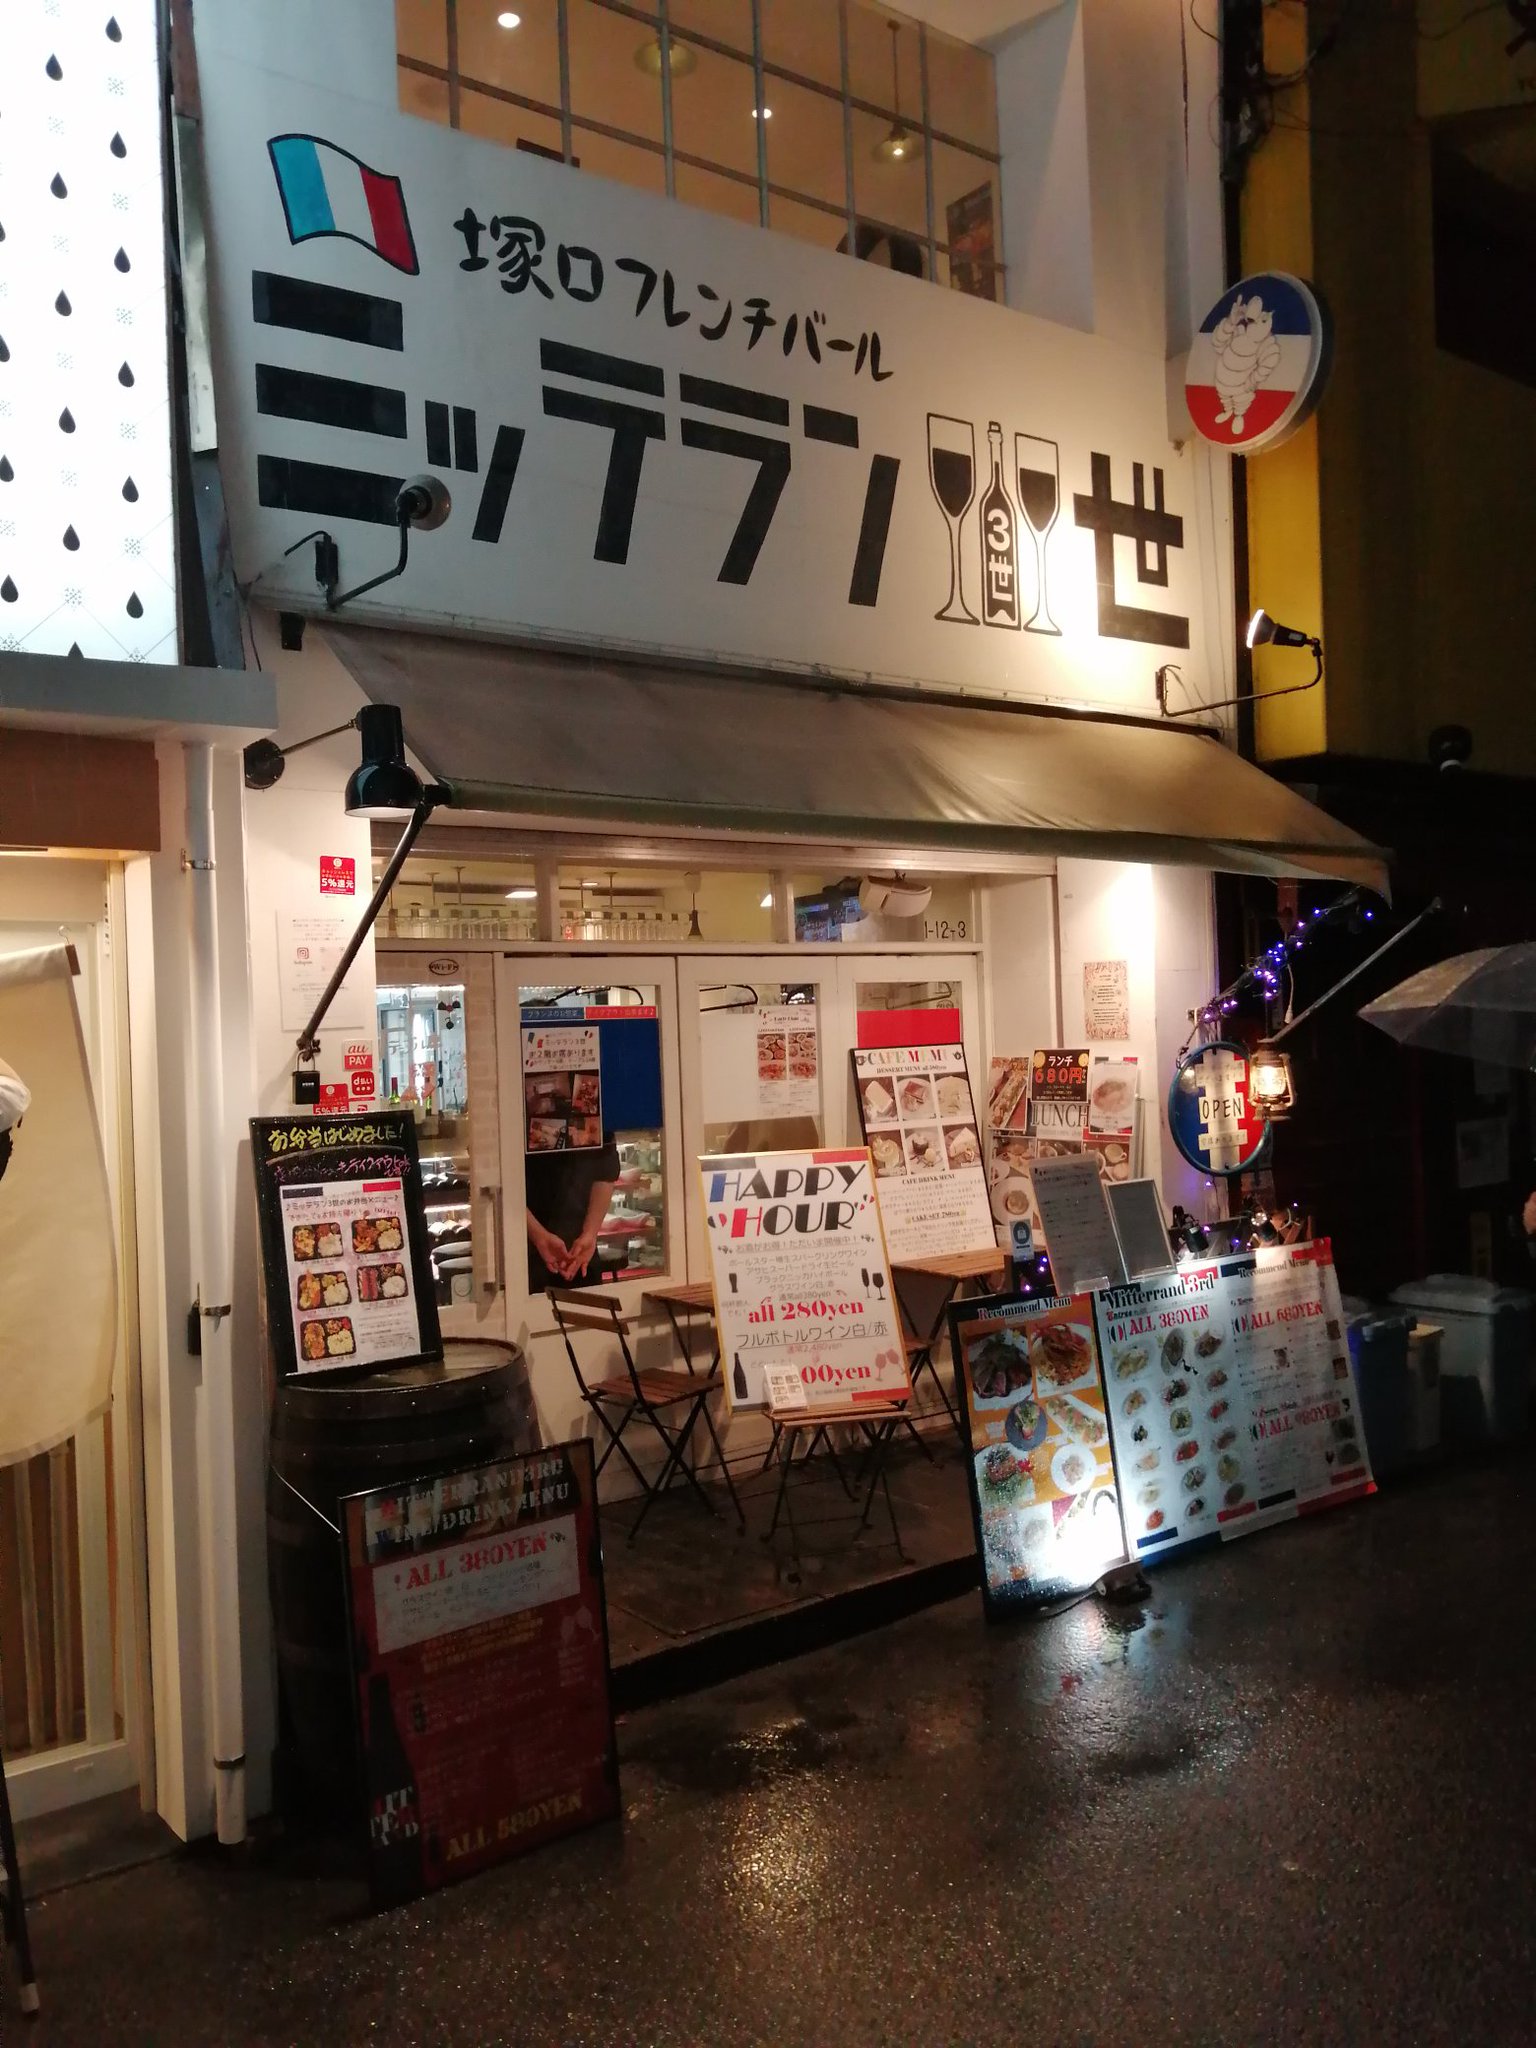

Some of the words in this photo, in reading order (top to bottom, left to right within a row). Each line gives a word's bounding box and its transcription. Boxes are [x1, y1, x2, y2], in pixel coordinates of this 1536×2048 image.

[453, 207, 893, 382] 塚口フレンチバール
[252, 270, 902, 607] ミッテラン
[924, 920, 967, 939] 1-12-3
[347, 1044, 369, 1054] au
[348, 1056, 368, 1066] PAY
[1048, 1055, 1073, 1067] ランチ
[1035, 1067, 1083, 1085] 680円
[1201, 1097, 1243, 1120] OPEN
[709, 1164, 866, 1203] HAPPY
[730, 1201, 856, 1238] HOUR
[1103, 1279, 1186, 1310] Mitterrand
[1188, 1272, 1215, 1293] 3rd
[748, 1303, 775, 1324] all
[780, 1299, 865, 1321] 280yen
[978, 1299, 1041, 1321] Recommend
[1042, 1296, 1071, 1310] Menu
[1129, 1315, 1157, 1336] ALL
[1158, 1304, 1210, 1329] 380YEN
[1250, 1311, 1275, 1330] ALL
[735, 1320, 889, 1348] フルボトルワイン白/赤
[1269, 1414, 1294, 1436] ALL
[406, 1558, 453, 1591] ALL
[459, 1532, 548, 1575] 380YEN
[446, 1825, 492, 1862] ALL
